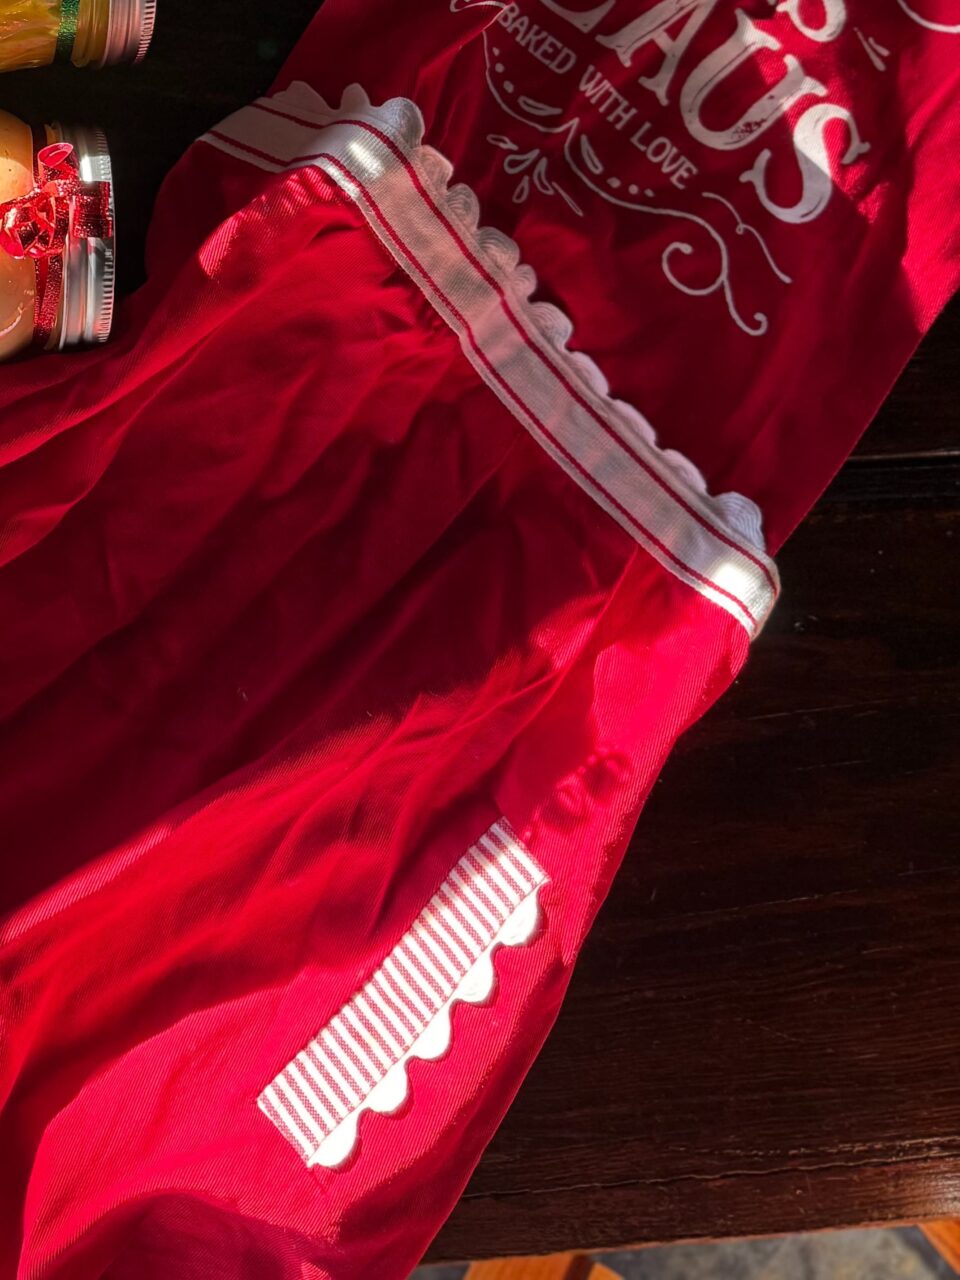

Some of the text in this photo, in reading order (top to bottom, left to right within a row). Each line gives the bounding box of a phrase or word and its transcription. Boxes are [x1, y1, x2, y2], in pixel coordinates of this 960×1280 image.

[497, 1, 699, 190] BAKED WITH LOVE
